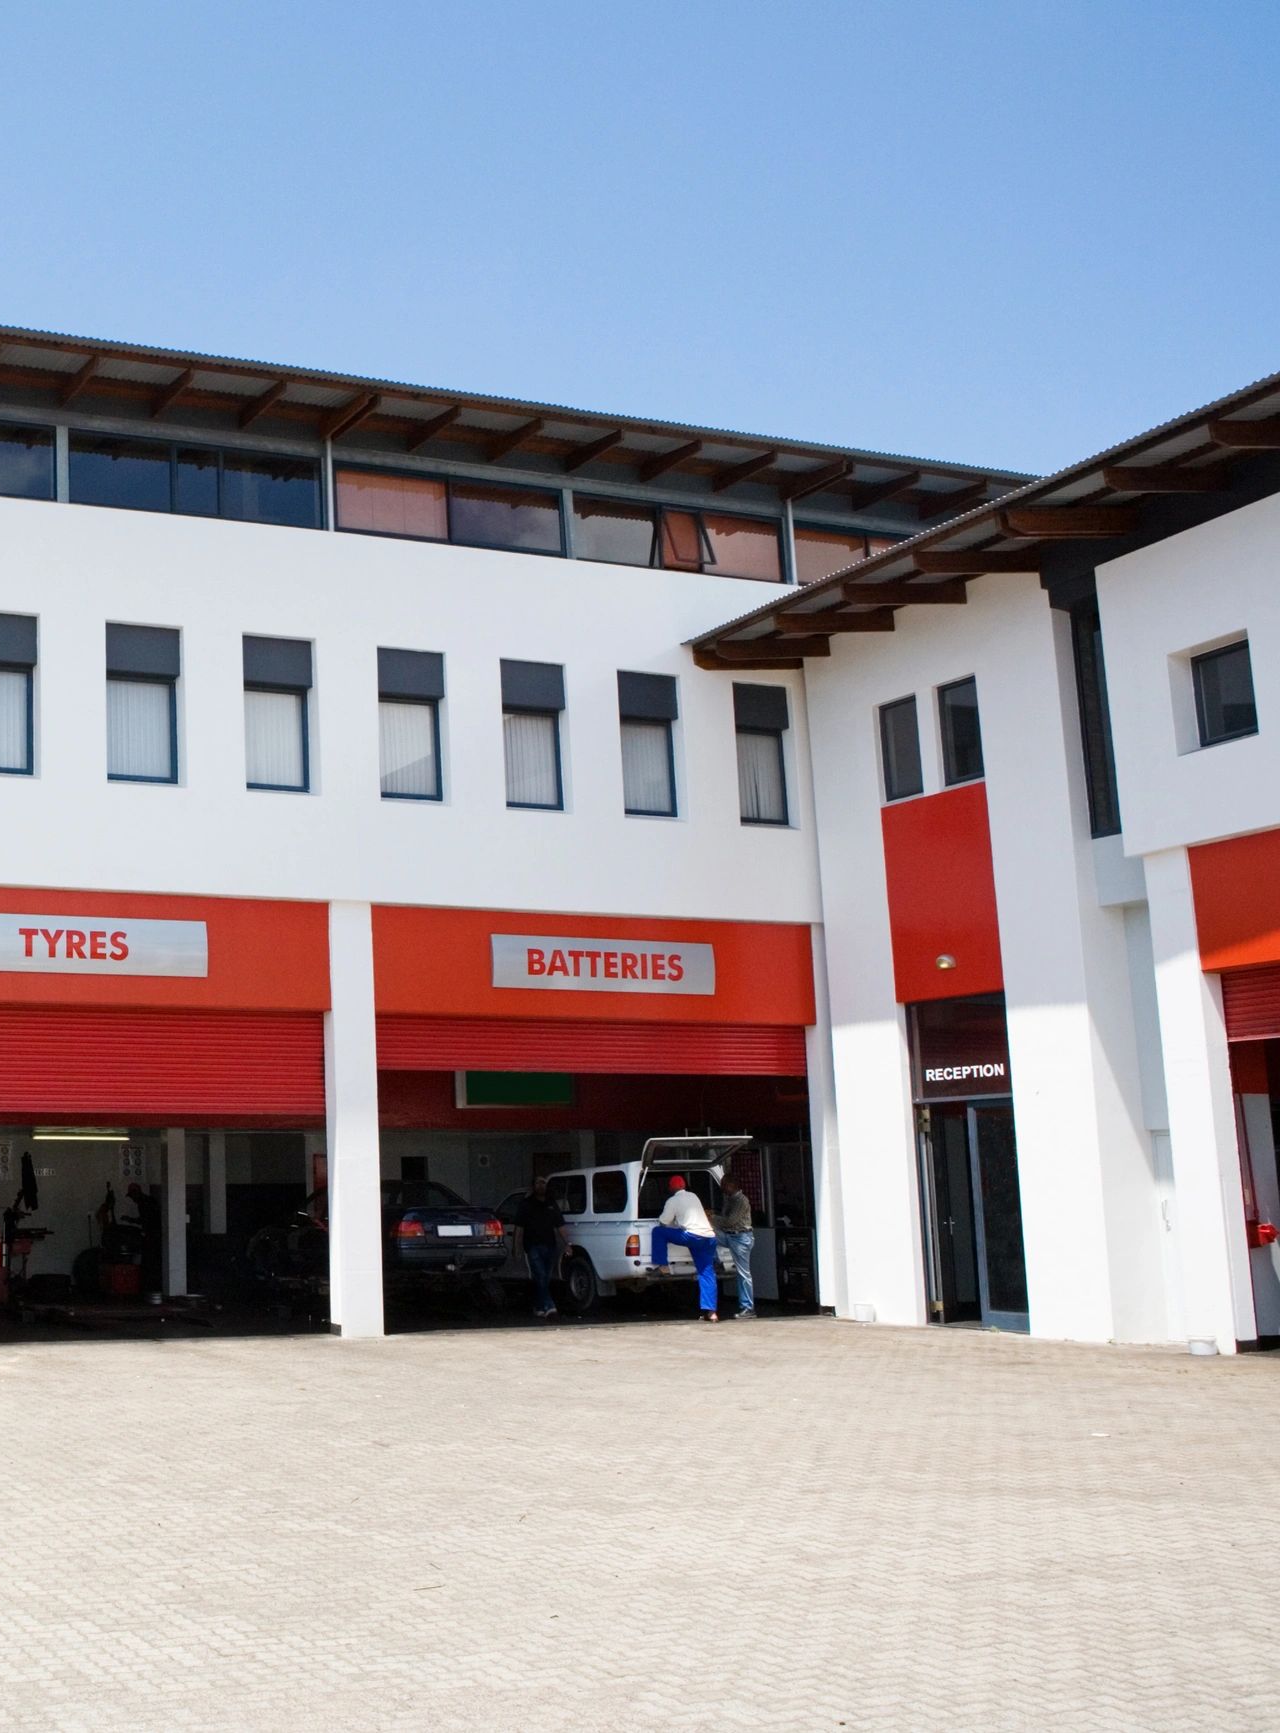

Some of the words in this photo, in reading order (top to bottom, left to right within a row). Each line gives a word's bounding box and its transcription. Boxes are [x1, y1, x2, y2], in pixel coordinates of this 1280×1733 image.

[18, 927, 129, 961] TYRES
[527, 948, 684, 982] BATTERIES
[925, 1063, 1005, 1082] RECEPTION
